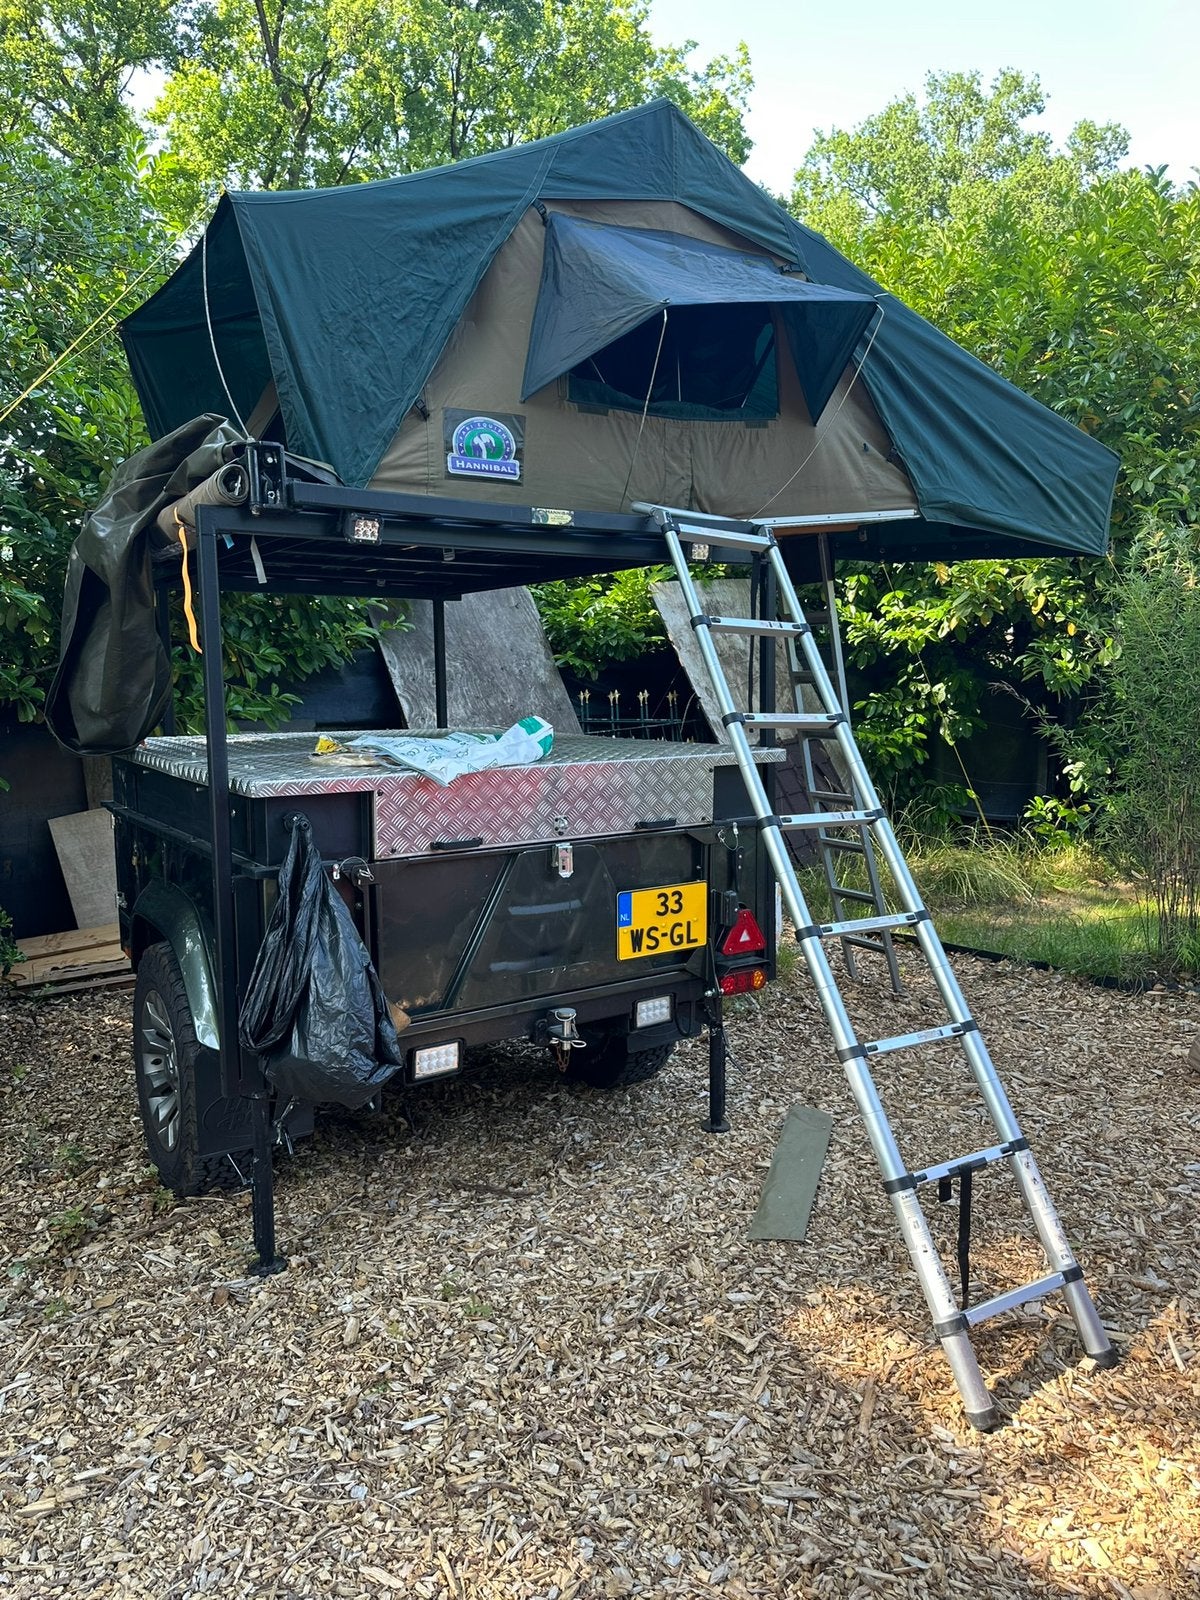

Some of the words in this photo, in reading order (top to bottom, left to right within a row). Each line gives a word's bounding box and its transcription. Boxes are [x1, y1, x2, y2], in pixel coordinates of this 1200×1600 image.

[456, 460, 515, 473] HANNIBAL
[656, 890, 683, 917] 33
[631, 921, 698, 953] WS-GL
